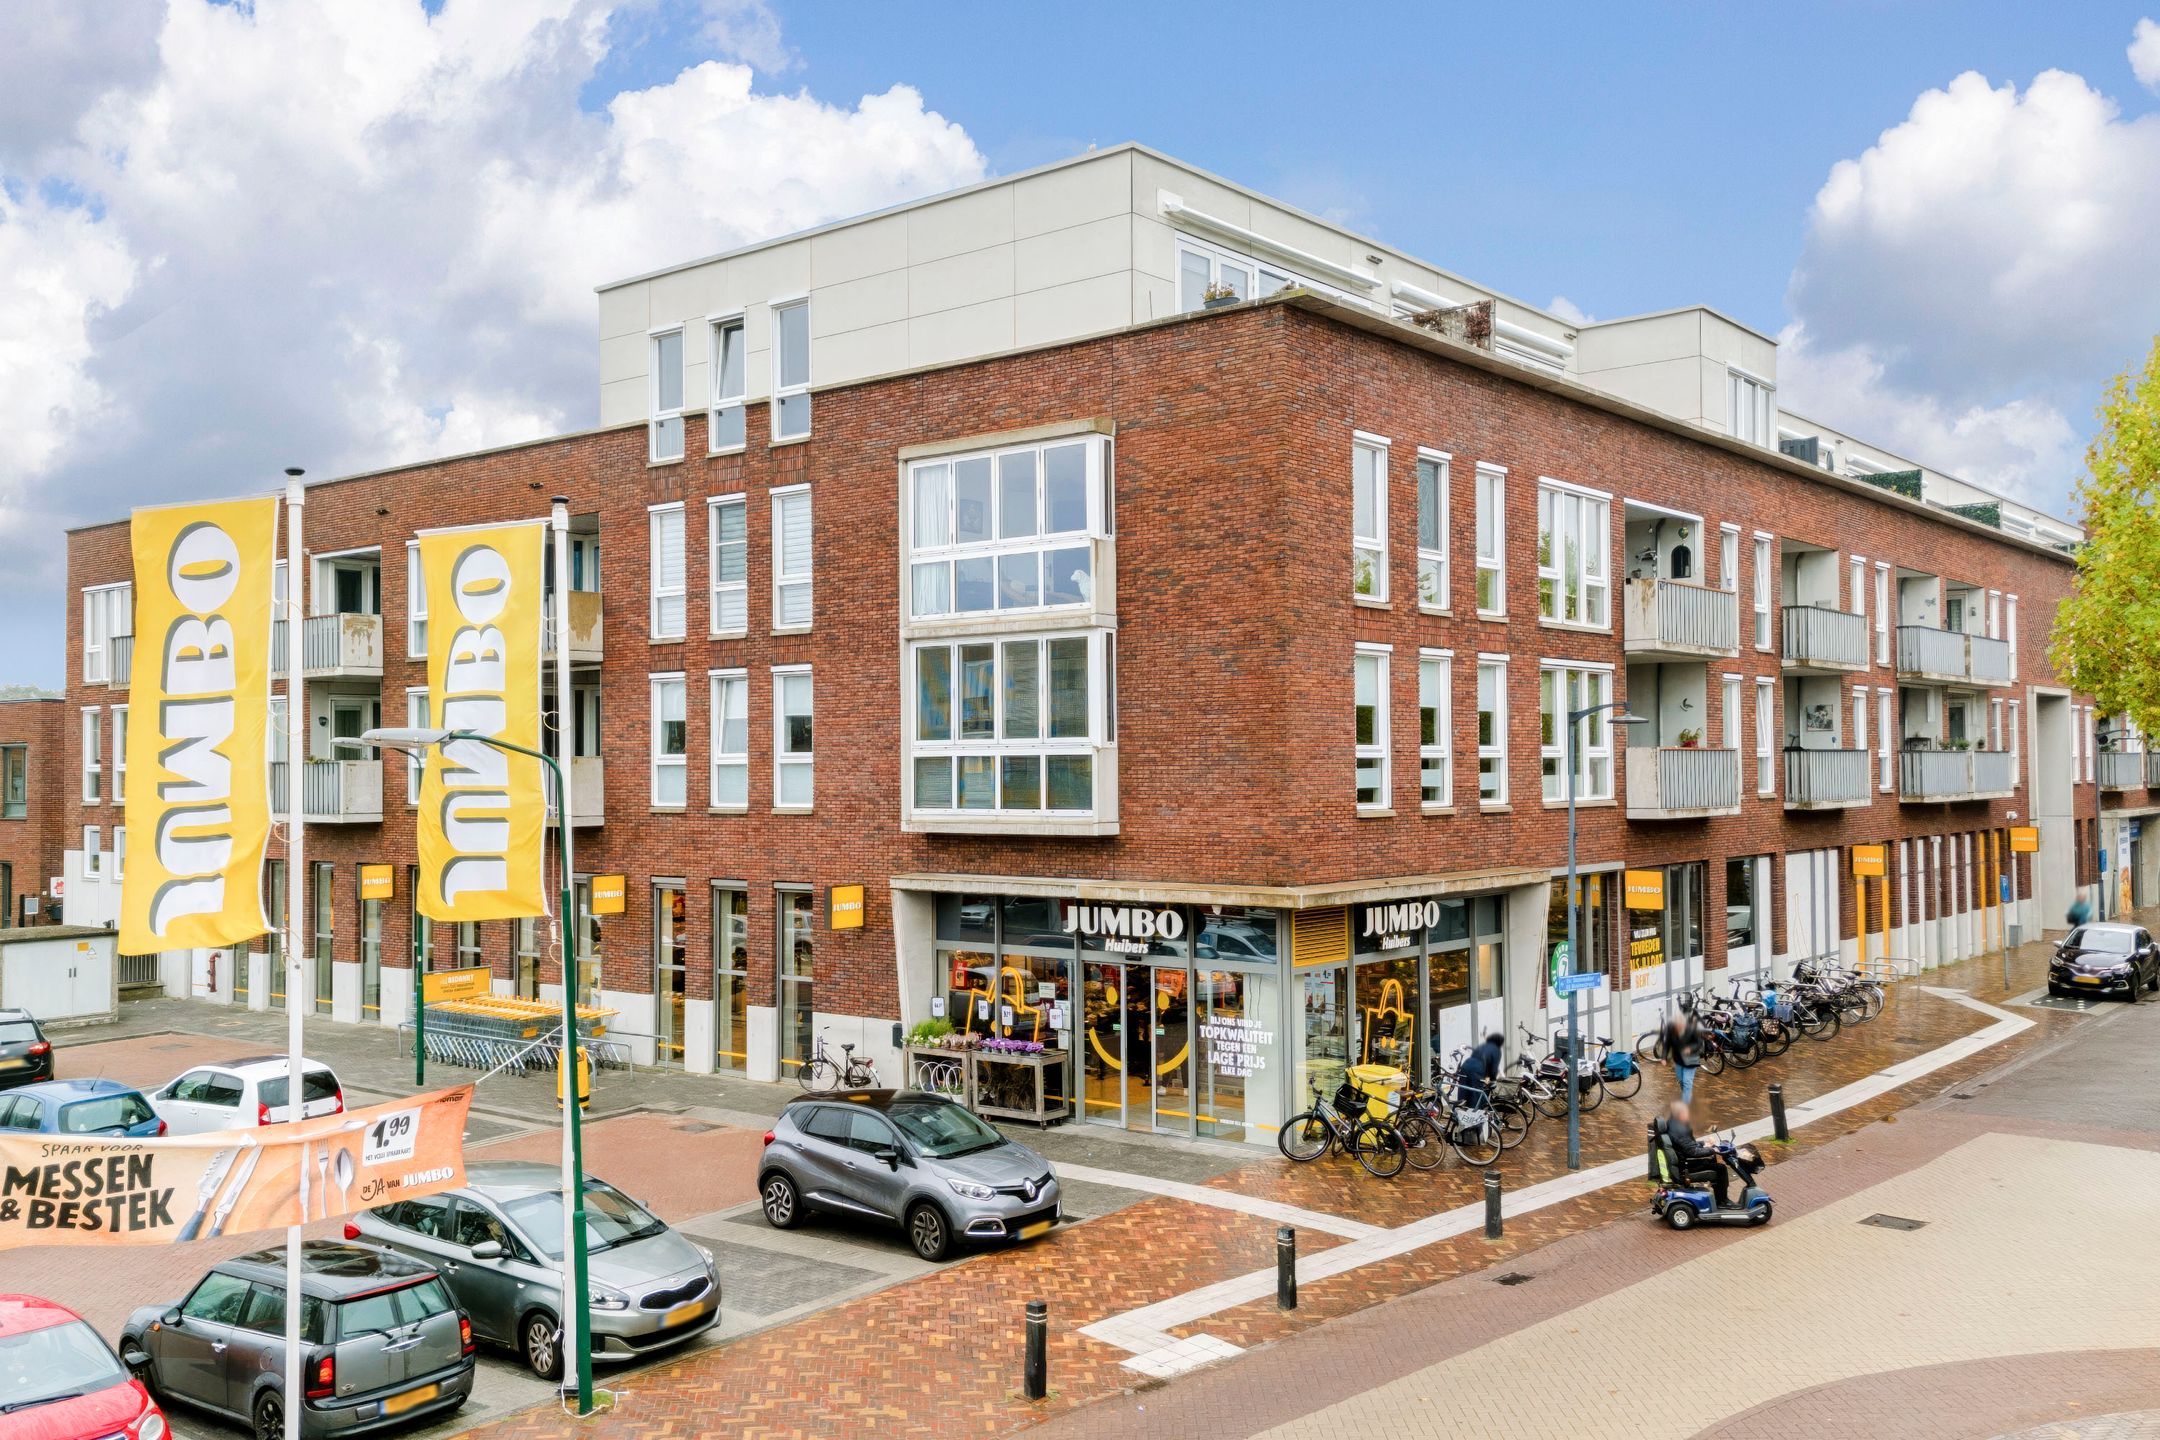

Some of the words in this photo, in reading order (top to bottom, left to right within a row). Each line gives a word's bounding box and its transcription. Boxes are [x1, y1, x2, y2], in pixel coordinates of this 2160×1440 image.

[149, 520, 240, 937] JUMBO
[440, 543, 511, 907] JUMBO
[594, 889, 623, 899] JUMBO
[1627, 885, 1661, 894] JUMBO
[833, 901, 862, 912] JUMBO
[1063, 905, 1184, 939] JUMBO
[1363, 900, 1440, 937] JUMBO
[1104, 938, 1149, 954] Huibers
[1382, 934, 1411, 951] Huibers
[1631, 938, 1661, 956] TEVREDEN
[1210, 1016, 1220, 1024] BIJ
[1222, 1017, 1235, 1026] ONS
[1237, 1018, 1253, 1028] VIND
[1200, 1025, 1273, 1045] TOPKWALITEIT
[1216, 1040, 1240, 1052] TEGEN
[1242, 1043, 1257, 1054] EEN
[1208, 1051, 1234, 1065] LAGE
[1237, 1054, 1265, 1069] PRIJS
[1221, 1066, 1235, 1075] ELKE
[1237, 1068, 1252, 1077] DAG
[372, 1115, 410, 1148] 1.99
[42, 1143, 94, 1158] SPAAR
[101, 1144, 143, 1153] VOOR
[2, 1153, 155, 1200] MESSEN
[387, 1179, 400, 1188] VAN
[402, 1166, 454, 1187] JUMBO
[361, 1177, 385, 1201] JA
[362, 1185, 371, 1193] DE
[0, 1198, 21, 1222] &
[26, 1187, 175, 1233] BESTEK
